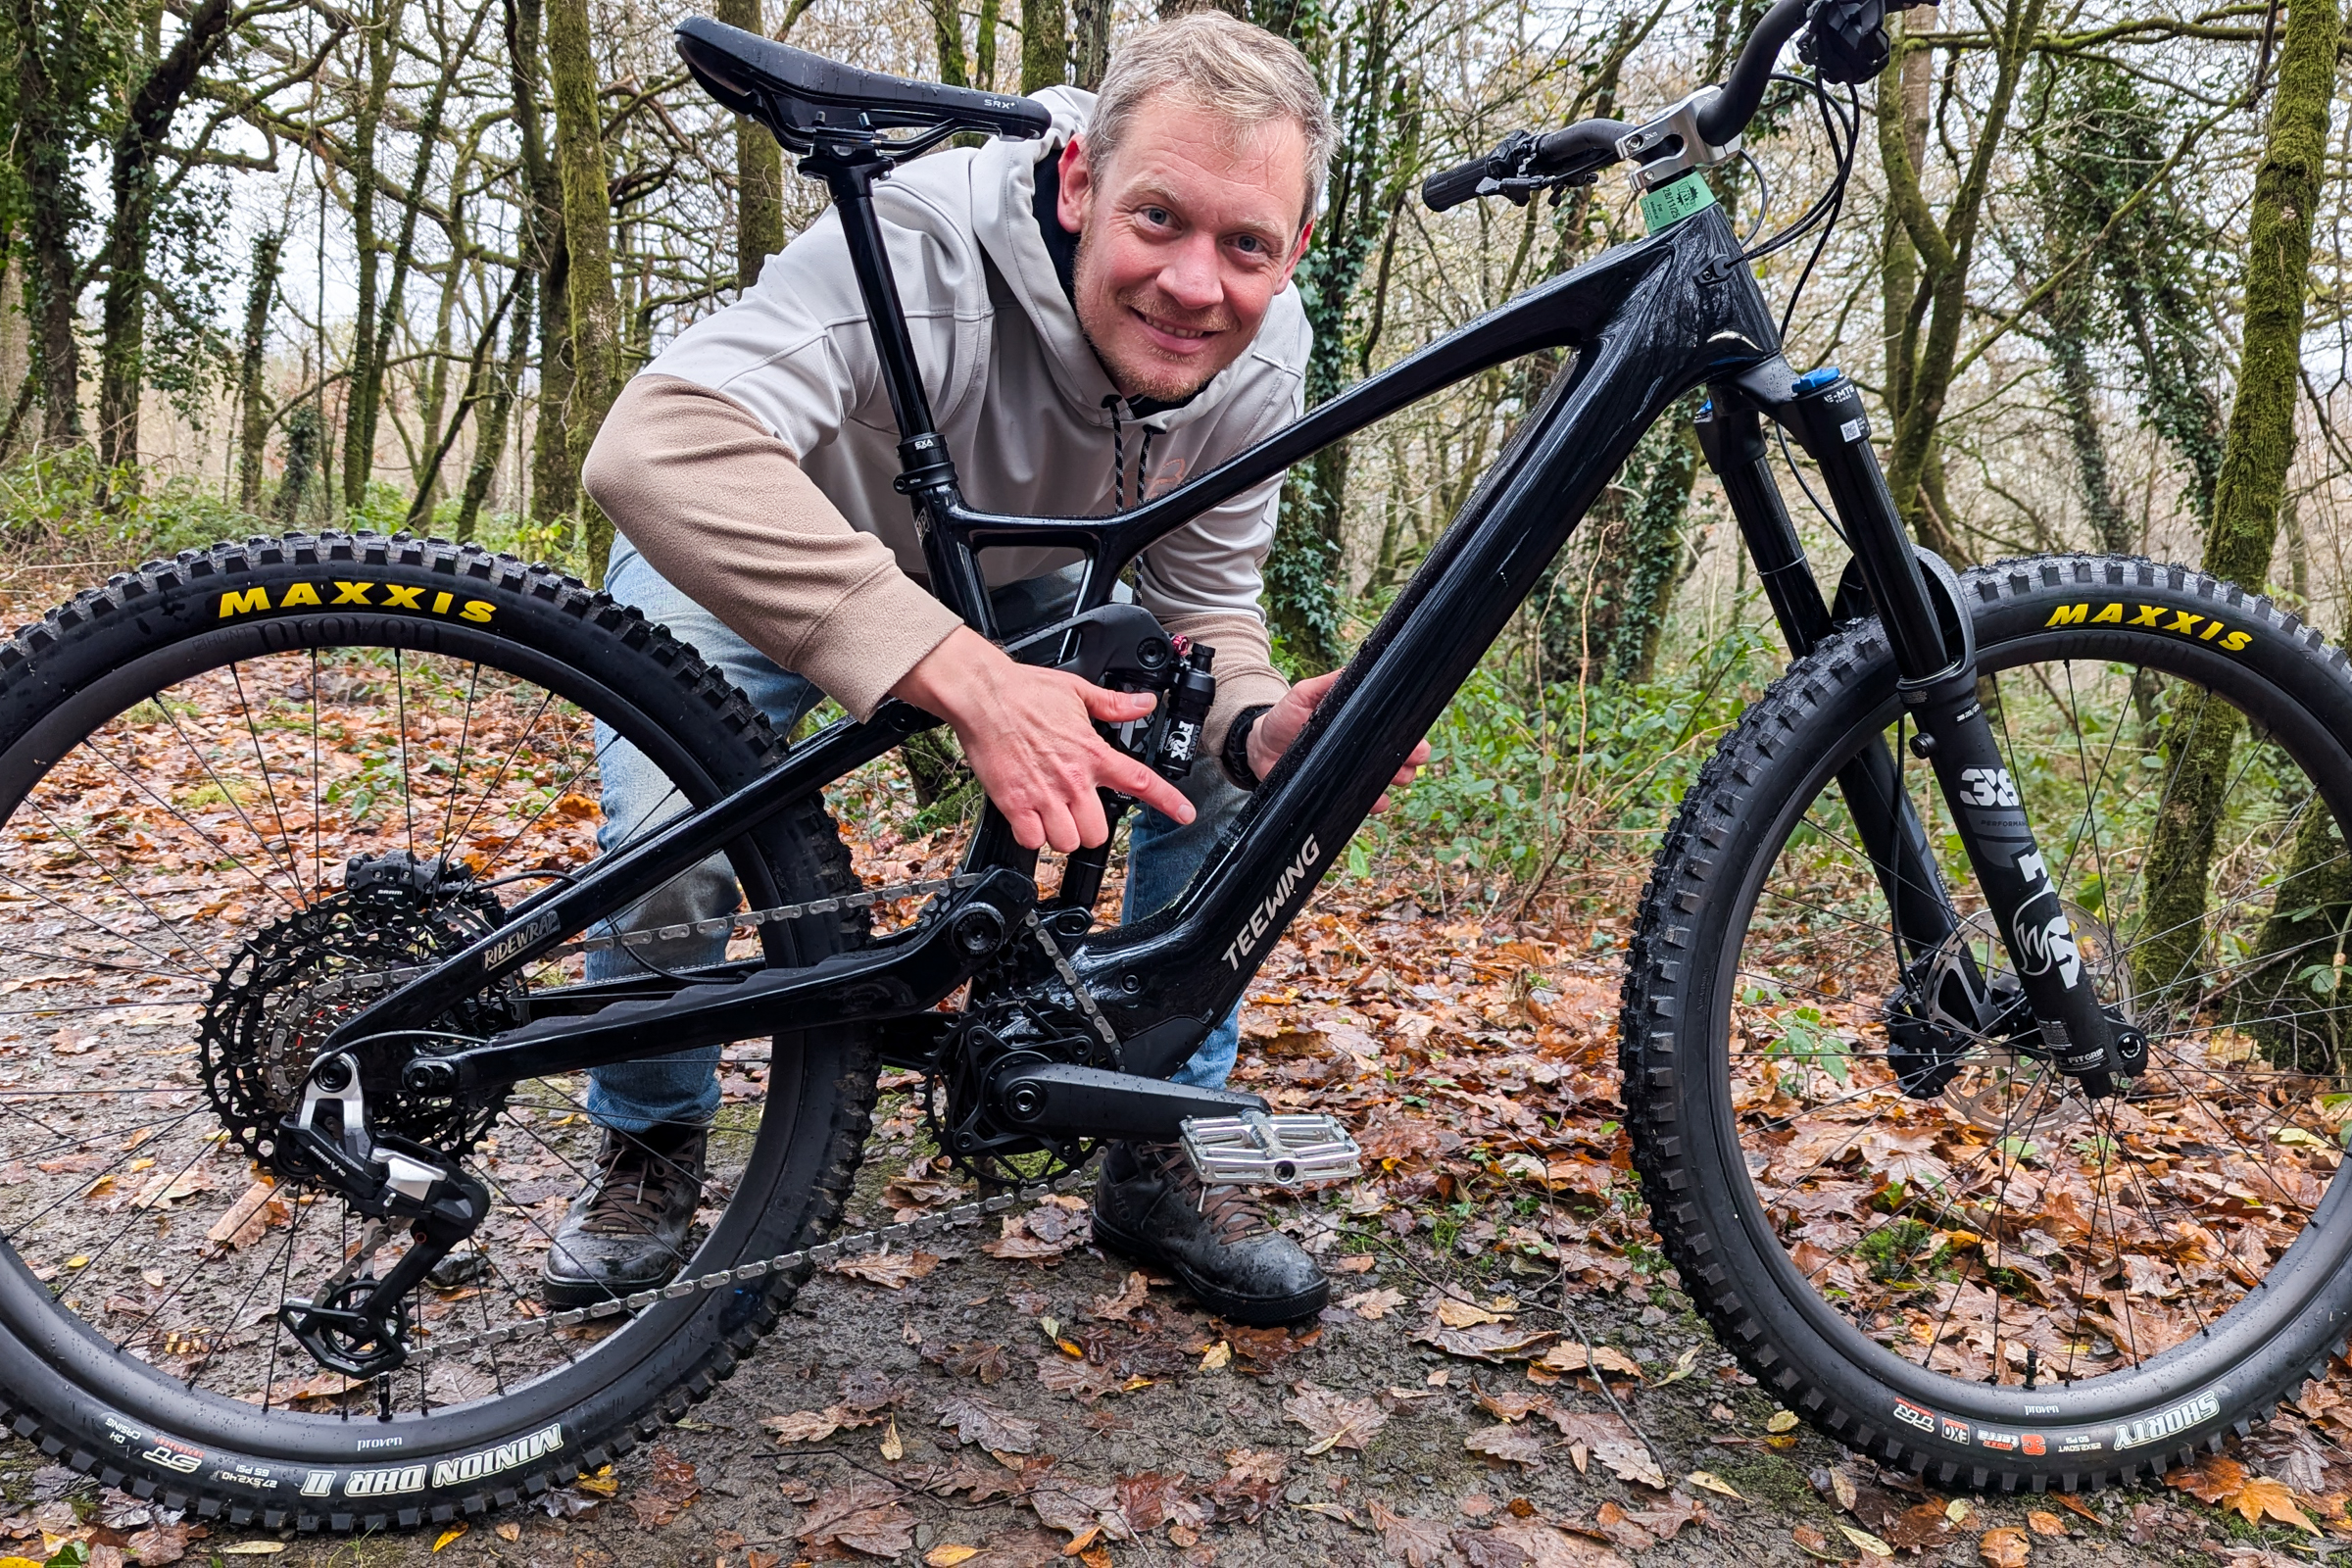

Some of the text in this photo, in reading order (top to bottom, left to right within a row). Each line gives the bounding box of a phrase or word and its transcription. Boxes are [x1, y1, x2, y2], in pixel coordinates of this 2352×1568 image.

[1662, 187, 1681, 220] 28/11/25
[914, 438, 934, 448] EXA
[219, 581, 497, 623] MAXXIS
[2044, 603, 2253, 652] MAXXIS
[1164, 720, 1195, 761] FOX
[1960, 768, 2020, 807] 38
[1981, 819, 2028, 828] PERFORMAN
[1221, 833, 1320, 970] TEEWING
[483, 909, 561, 969] RIDEWRAP
[2084, 1048, 2104, 1061] GRIP
[309, 1145, 332, 1167] SRAM
[1893, 1403, 1936, 1433] TR
[2025, 1404, 2059, 1415] proven
[2114, 1390, 2220, 1451] SHORTY
[105, 1417, 141, 1441] CASING
[109, 1431, 125, 1445] DH
[1942, 1425, 1969, 1444] EXO
[1978, 1430, 2019, 1447] terra
[2065, 1436, 2076, 1445] PSI
[357, 1437, 403, 1451] proven
[432, 1423, 564, 1488] MINION
[142, 1446, 202, 1474] ST
[236, 1464, 252, 1473] PSI
[344, 1464, 427, 1497] DHR
